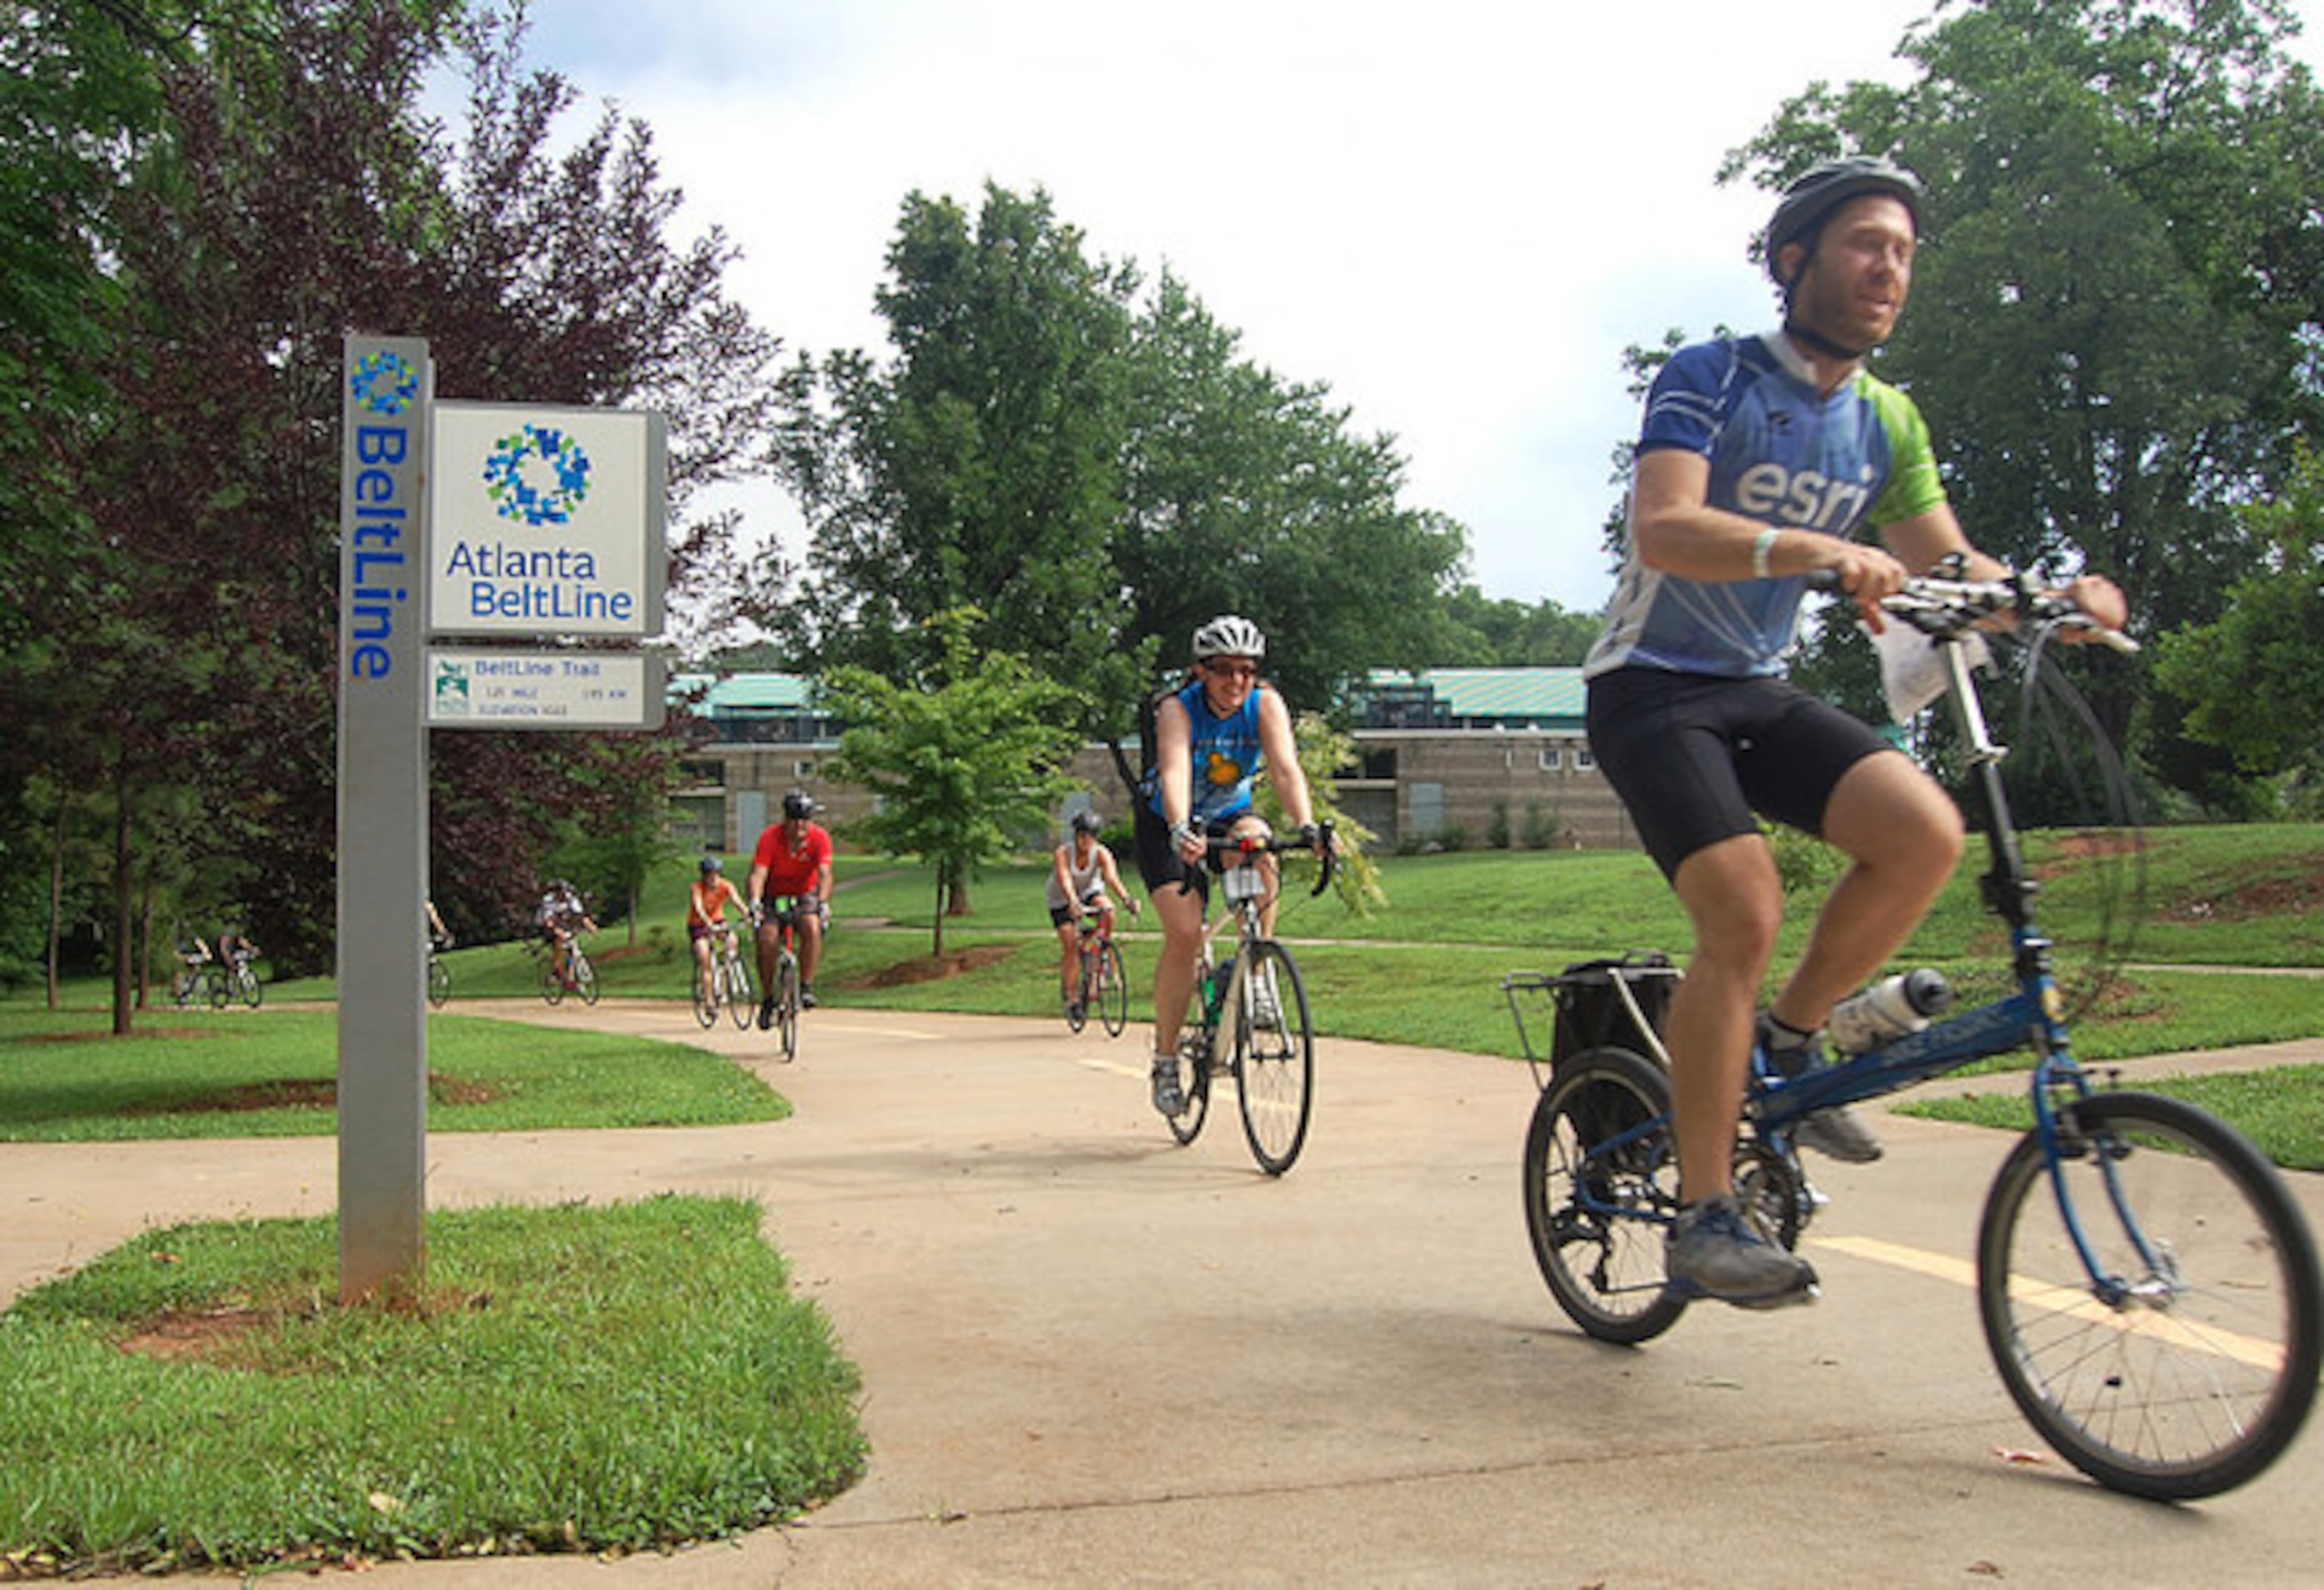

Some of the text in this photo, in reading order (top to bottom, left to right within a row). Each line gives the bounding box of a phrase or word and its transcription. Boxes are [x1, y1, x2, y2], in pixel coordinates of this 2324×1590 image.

[1737, 463, 1874, 535] esri
[352, 426, 407, 679] BeltLine
[447, 541, 596, 580] Atlanta
[471, 581, 632, 620] BeltLine
[475, 661, 600, 676] BeltLine Trail
